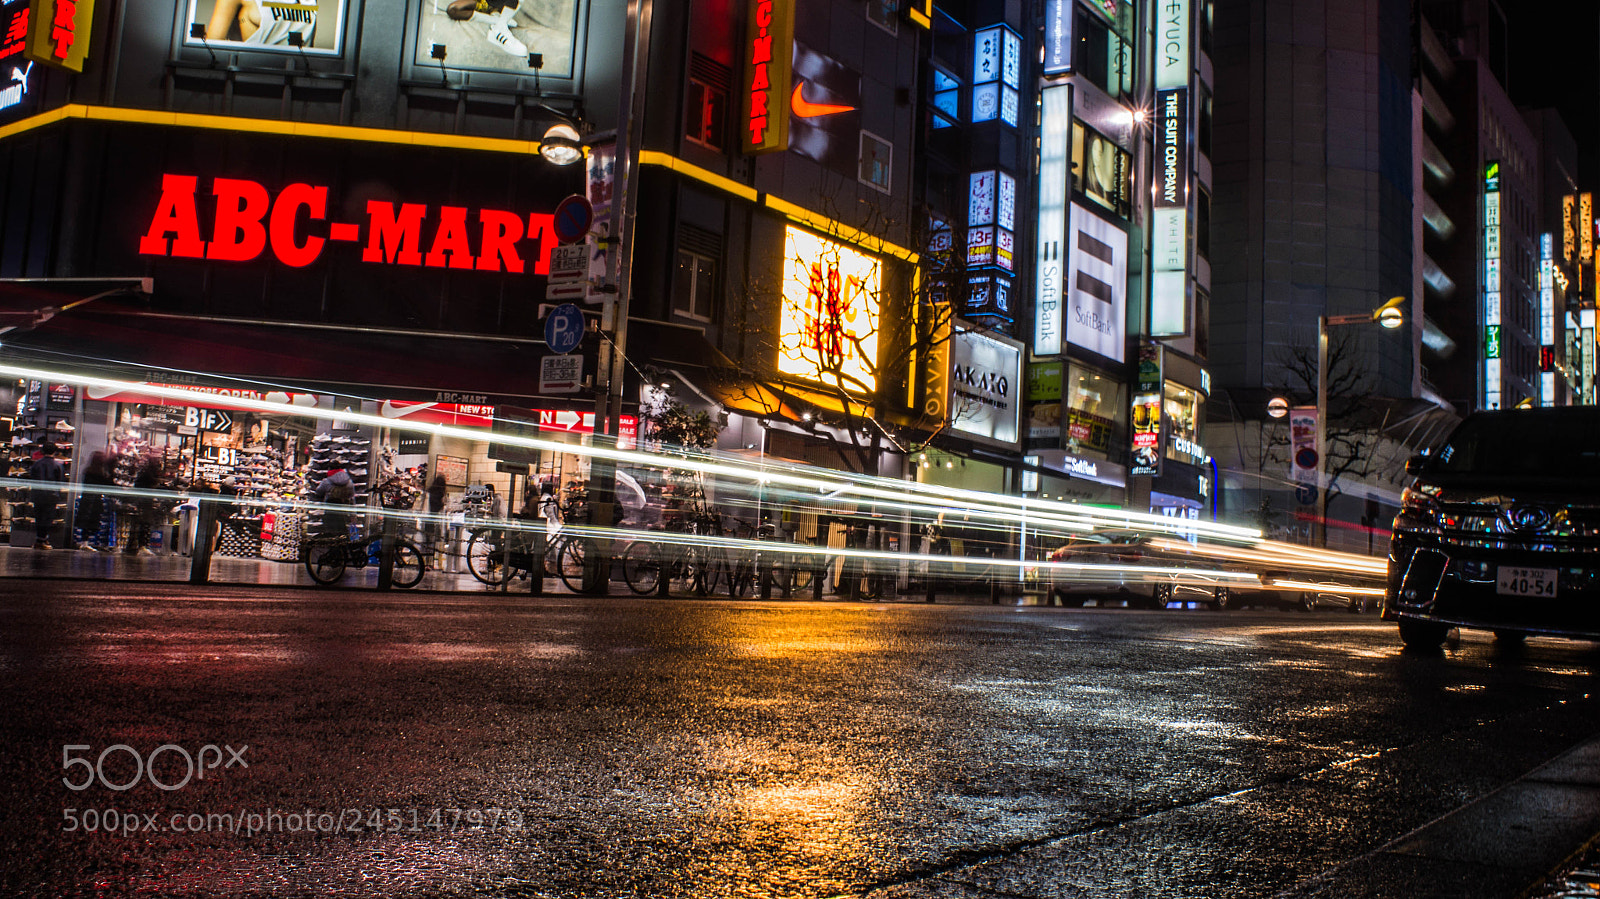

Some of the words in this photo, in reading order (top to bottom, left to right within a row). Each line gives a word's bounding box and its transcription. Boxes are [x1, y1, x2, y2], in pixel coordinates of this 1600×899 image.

[271, 7, 312, 25] PUMA
[52, 0, 77, 59] RT
[1164, 0, 1181, 68] EYUCA
[748, 0, 773, 145] C-MART
[1165, 92, 1178, 118] THE
[1165, 118, 1178, 145] SUIT
[1164, 145, 1178, 203] COMPANY
[138, 173, 560, 276] ABC-MART
[975, 230, 992, 244] 3F
[1001, 232, 1012, 248] 3F
[1168, 214, 1178, 265] WHITE
[1040, 265, 1058, 342] SoftBank
[552, 315, 569, 346] P
[1074, 304, 1112, 337] SoftBank
[562, 331, 575, 346] 20
[436, 391, 488, 404] ABC-MART
[460, 404, 480, 414] NEW
[185, 405, 217, 430] B1F
[1071, 456, 1098, 477] SoftBank
[1509, 578, 1554, 596] 40-54
